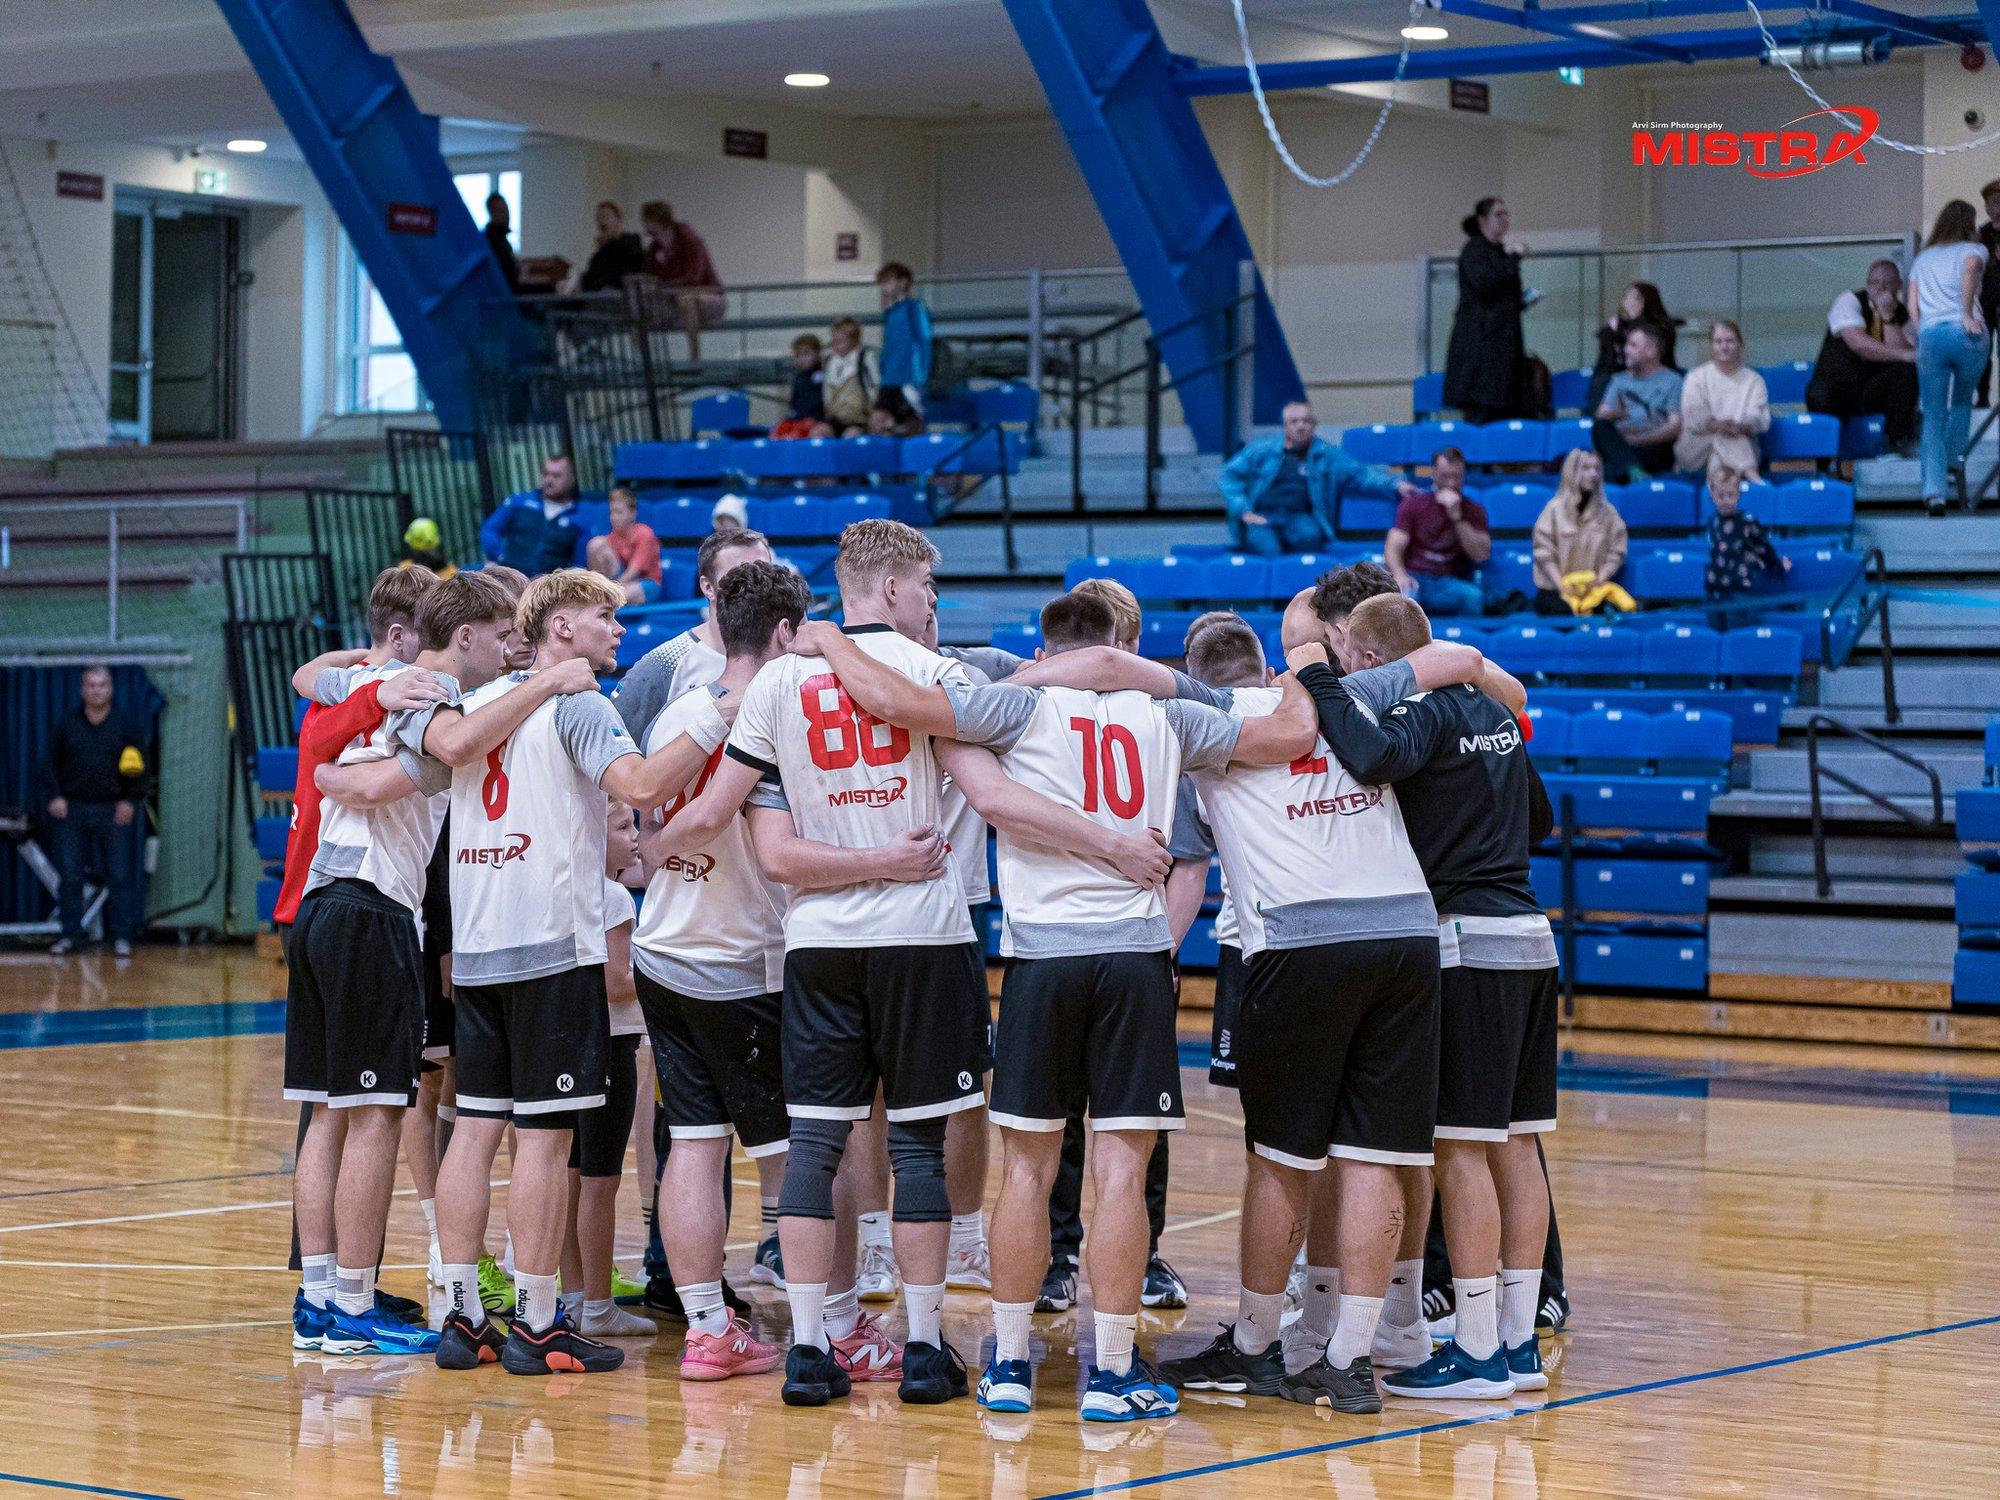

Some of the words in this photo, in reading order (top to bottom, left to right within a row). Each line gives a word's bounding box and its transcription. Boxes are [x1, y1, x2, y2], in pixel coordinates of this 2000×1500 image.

[1070, 716, 1145, 820] 10
[1286, 790, 1385, 821] MISTRA
[453, 1281, 466, 1315] Kempa
[516, 1288, 531, 1320] Kempa
